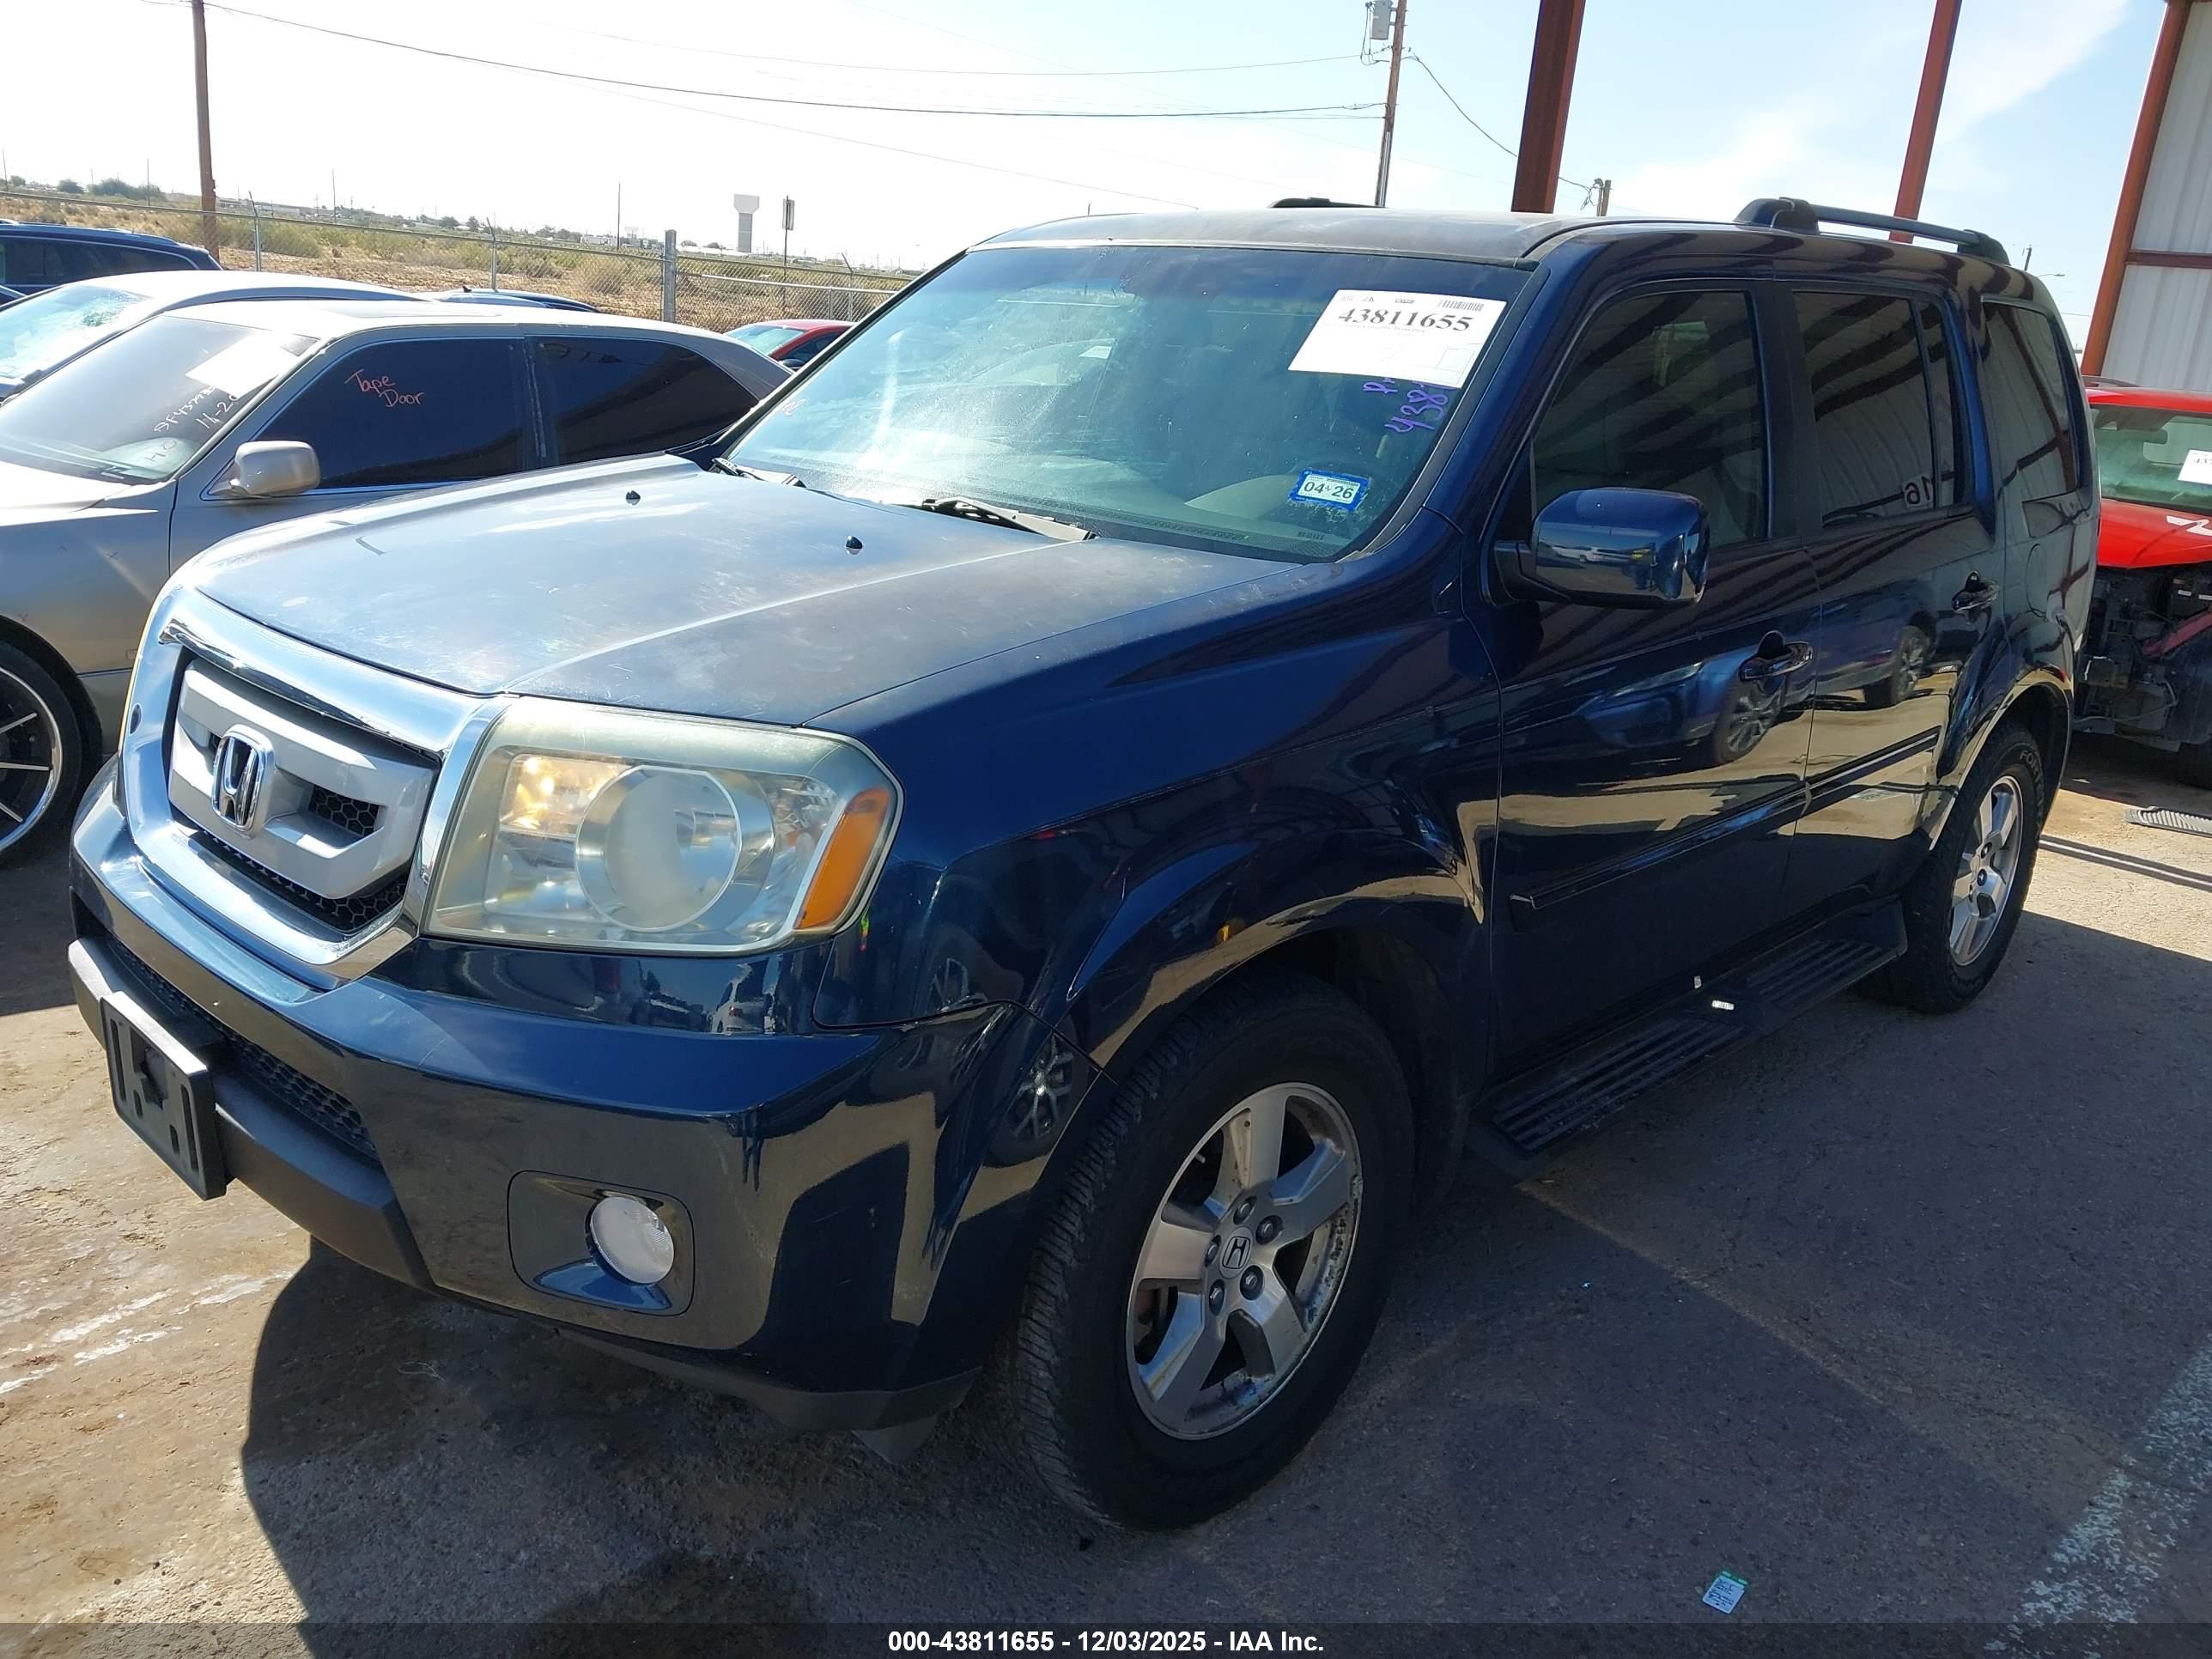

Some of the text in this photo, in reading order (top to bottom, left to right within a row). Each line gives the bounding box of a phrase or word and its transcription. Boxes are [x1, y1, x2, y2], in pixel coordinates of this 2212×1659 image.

[1338, 307, 1474, 331] 43811655
[344, 368, 395, 397] Tape
[379, 389, 426, 407] Door
[1304, 481, 1324, 494] 04
[1331, 485, 1354, 499] 26
